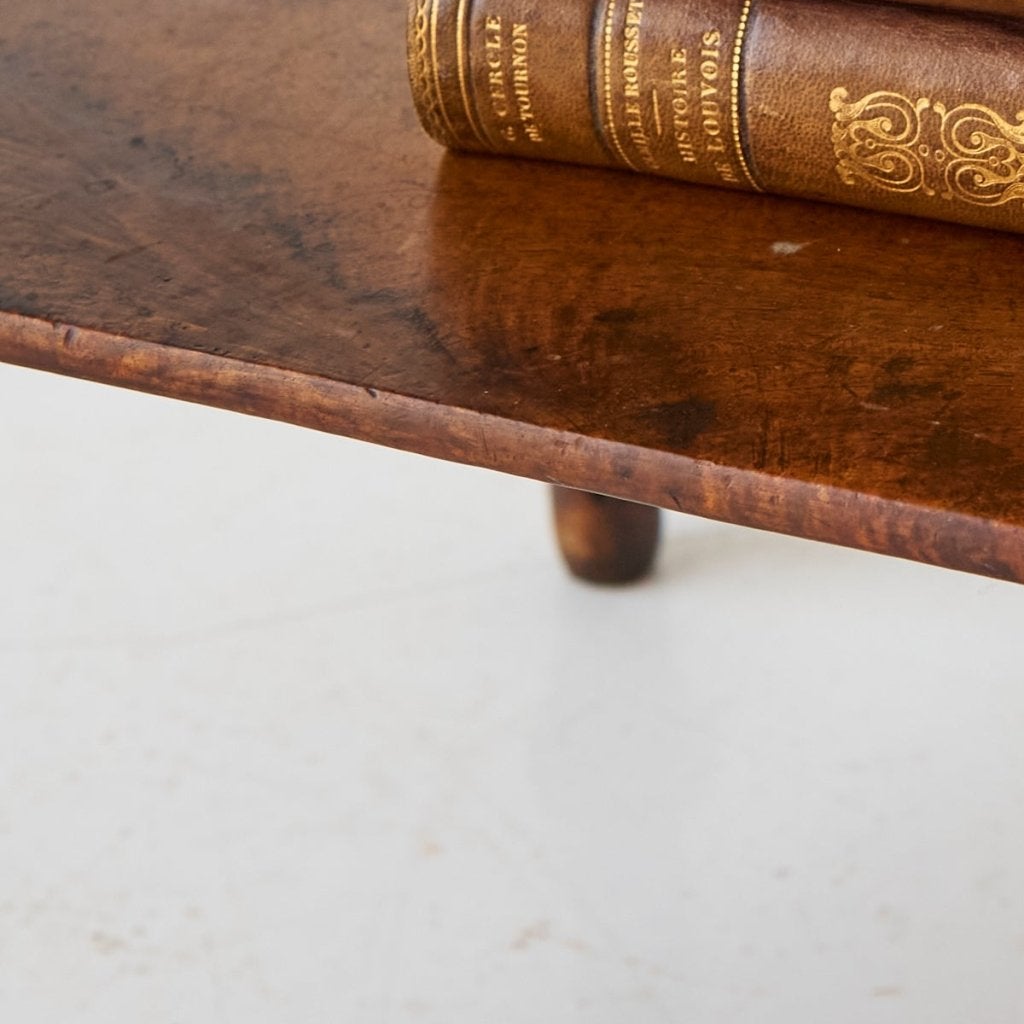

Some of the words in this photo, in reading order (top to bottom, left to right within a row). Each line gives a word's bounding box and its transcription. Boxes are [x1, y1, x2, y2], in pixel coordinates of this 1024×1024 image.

[486, 15, 508, 118] CERCLE
[512, 23, 535, 121] TOURNON
[671, 48, 698, 163] HISTOIRE
[700, 28, 725, 154] LOUVOIS
